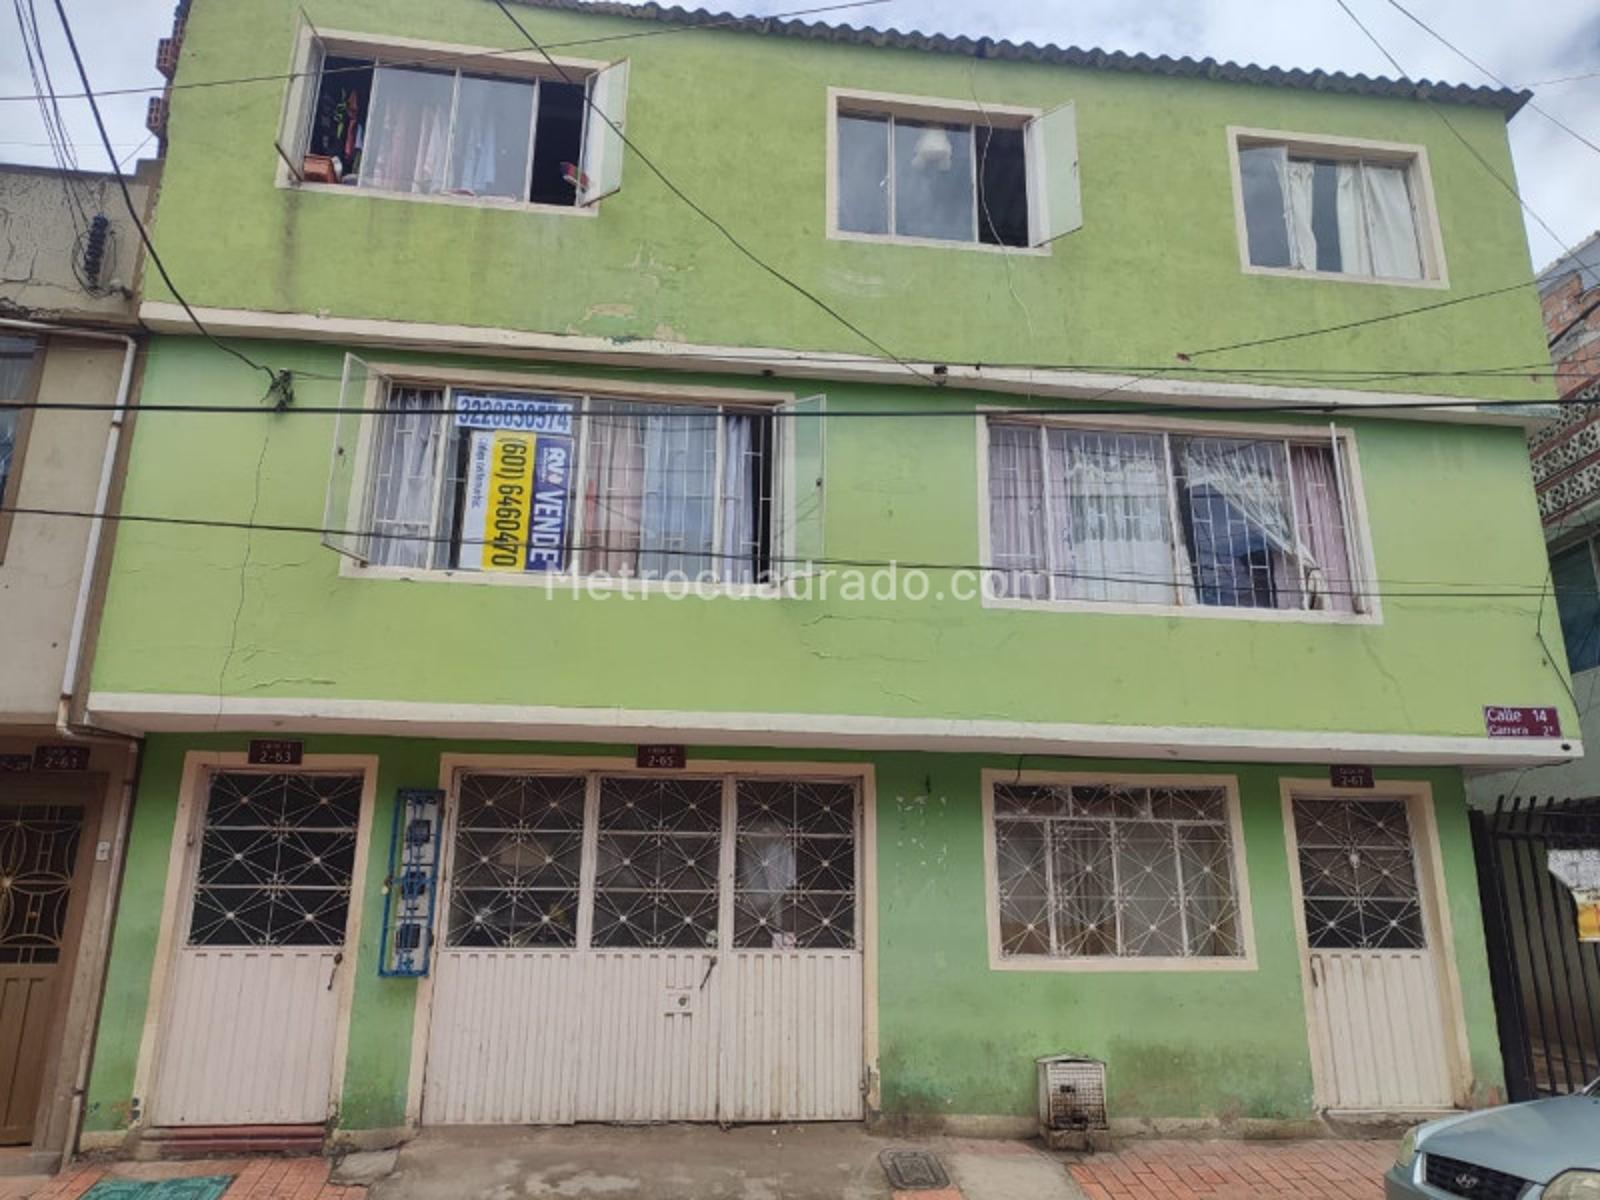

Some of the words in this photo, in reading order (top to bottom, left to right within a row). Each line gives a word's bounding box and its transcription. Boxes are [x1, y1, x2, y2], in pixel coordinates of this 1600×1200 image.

[494, 437, 528, 480] (601)
[491, 484, 524, 568] 6460470
[529, 490, 563, 564] VENDE
[1487, 707, 1522, 723] Calle
[1531, 708, 1548, 723] 14
